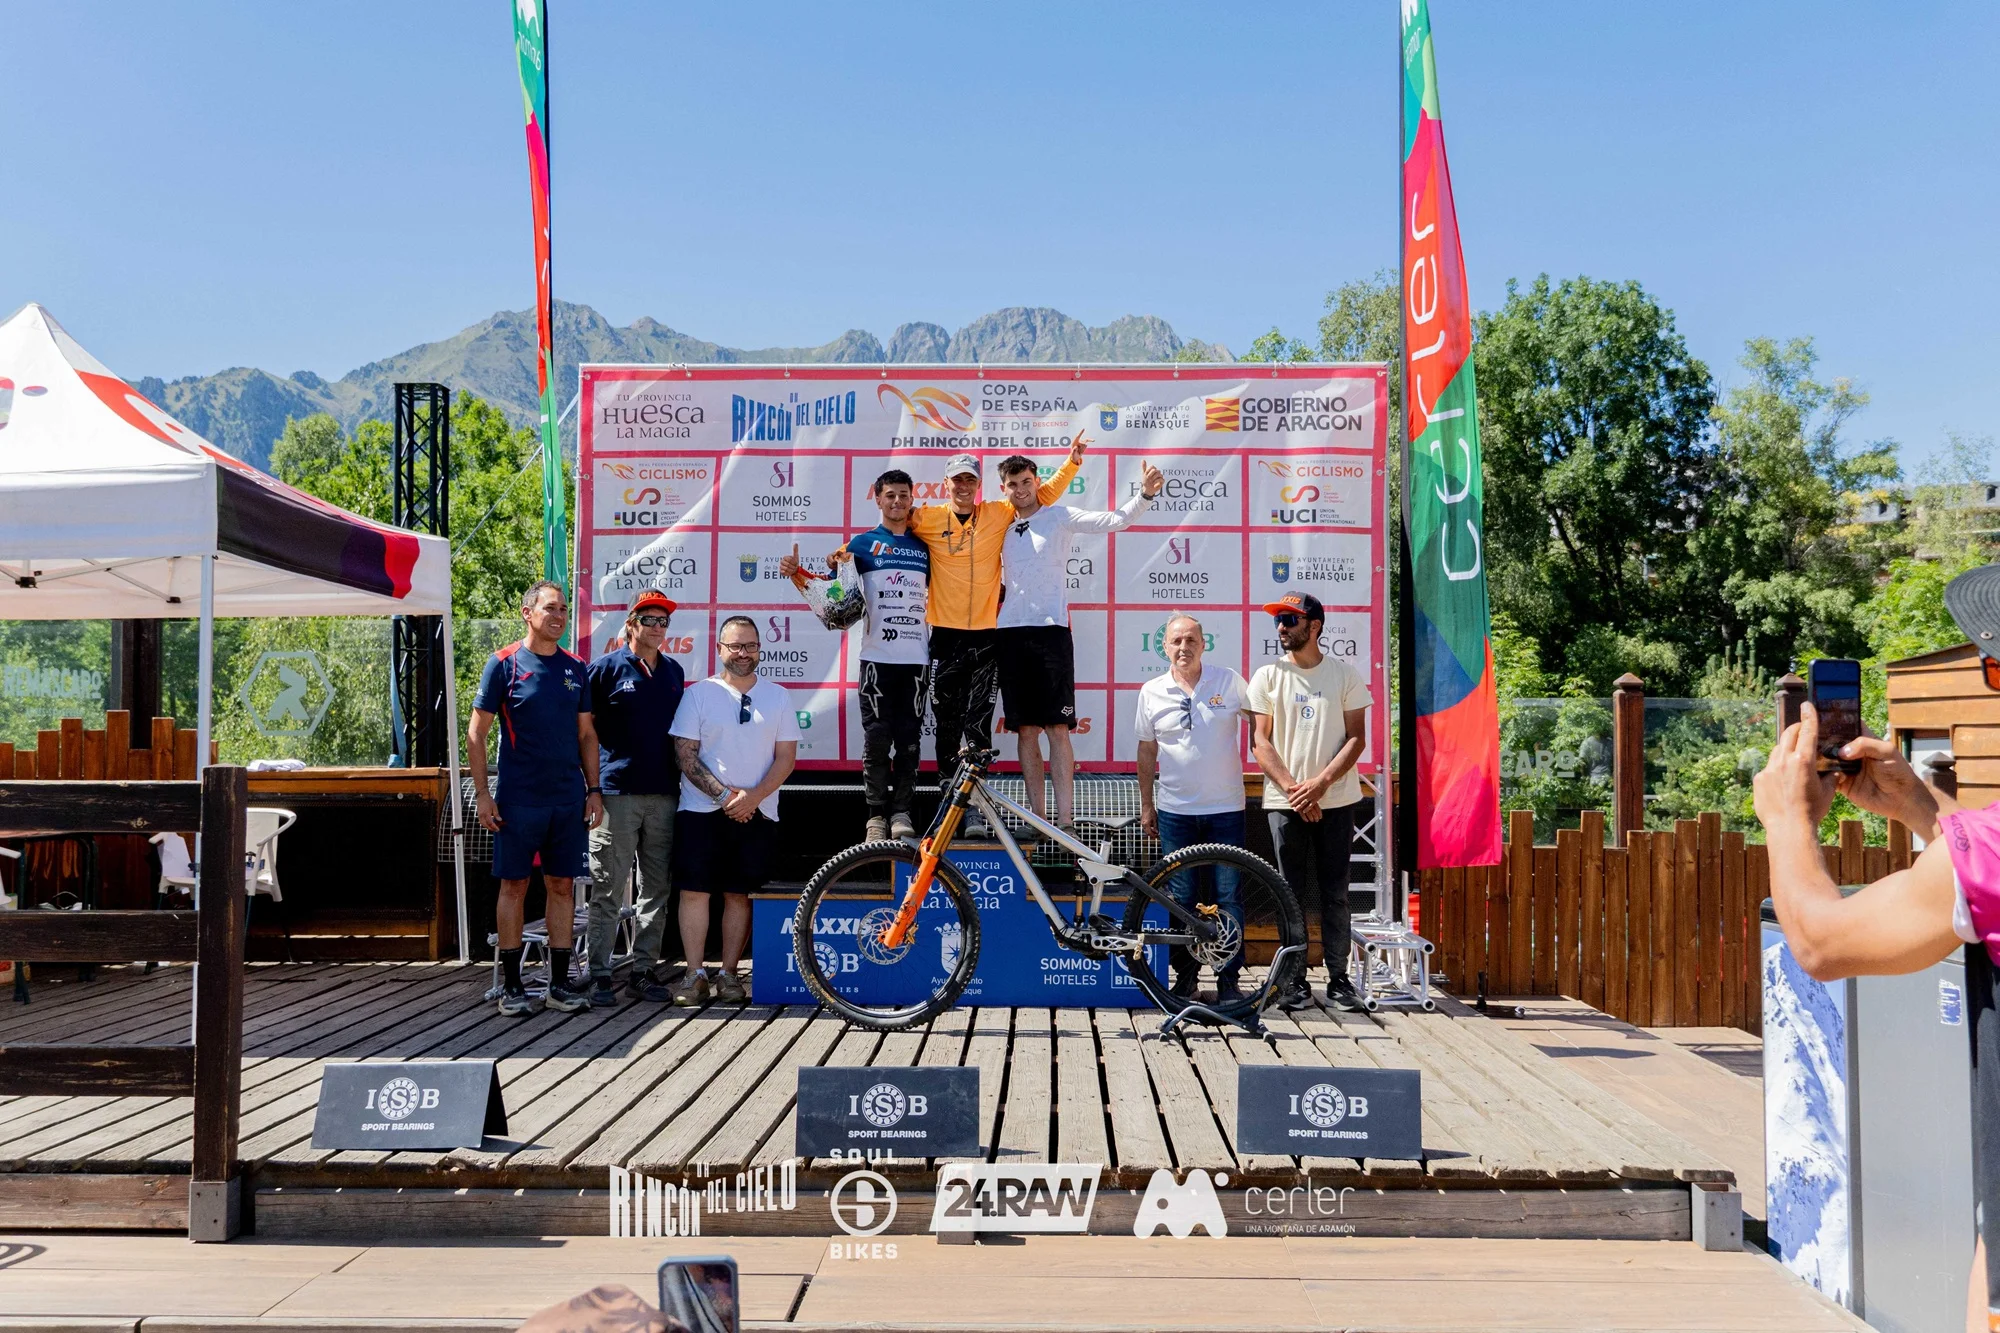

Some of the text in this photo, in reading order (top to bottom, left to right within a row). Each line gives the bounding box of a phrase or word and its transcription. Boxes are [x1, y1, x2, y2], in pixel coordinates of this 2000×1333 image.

[982, 384, 1029, 396] COPA
[1410, 193, 1481, 581] cerler
[982, 397, 1078, 412] DE ESPAÑA
[1242, 396, 1347, 414] GOBIERNO
[732, 390, 856, 443] RINCÓN DEL CIELO
[1142, 412, 1178, 420] VILLA
[982, 421, 1006, 431] BTT
[1011, 421, 1030, 431] DH
[1125, 420, 1190, 430] BENASQUE
[1242, 416, 1269, 432] DE
[891, 434, 1072, 448] DH RINCÓN DEL CIELO
[638, 469, 708, 480] CICLISMO
[1296, 466, 1363, 478] CICLISMO
[752, 495, 811, 507] SOMMOS
[622, 511, 658, 526] UCI
[755, 511, 807, 521] HOTELES
[1280, 509, 1317, 524] UCI
[885, 547, 928, 559] ROSENDO
[1312, 563, 1344, 572] VILLA
[1148, 572, 1209, 584] SOMMOS
[1296, 572, 1355, 583] BENASQUE
[1152, 588, 1205, 599] HOTELES
[758, 650, 808, 663] OMMOS
[1040, 958, 1102, 971] SOMMOS
[1044, 974, 1097, 986] HOTELES
[361, 1123, 435, 1131] SPORT BEARINGS
[848, 1130, 927, 1139] SPORT BEARINGS
[1288, 1129, 1369, 1140] SPORT BEARINGS
